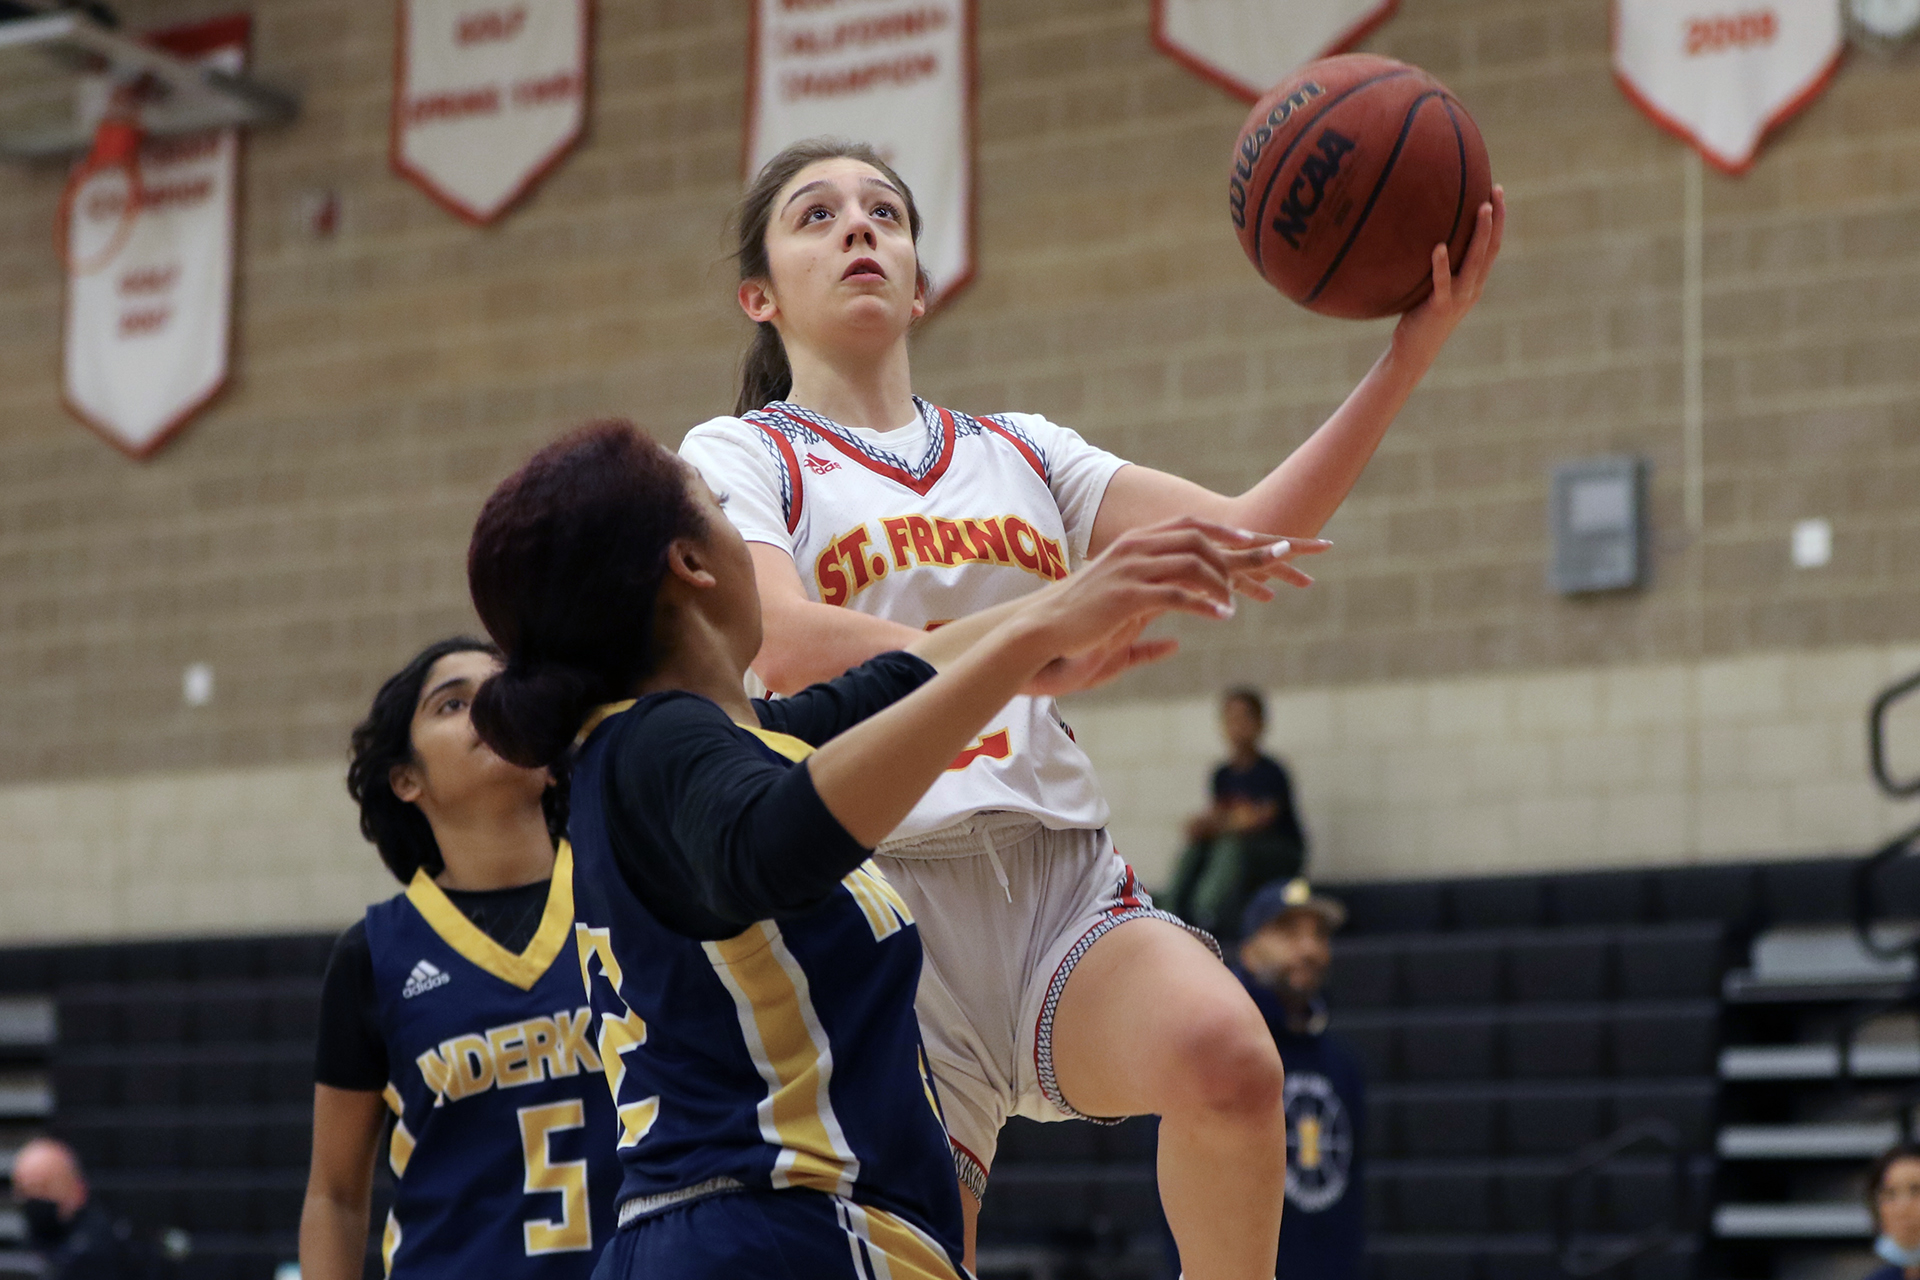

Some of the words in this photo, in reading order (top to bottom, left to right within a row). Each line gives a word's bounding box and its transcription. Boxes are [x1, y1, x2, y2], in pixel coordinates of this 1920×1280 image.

[1230, 81, 1327, 230] Wilson
[1272, 127, 1355, 249] NCAA
[814, 522, 889, 608] ST.
[402, 973, 450, 999] adidas
[517, 1099, 592, 1256] 5
